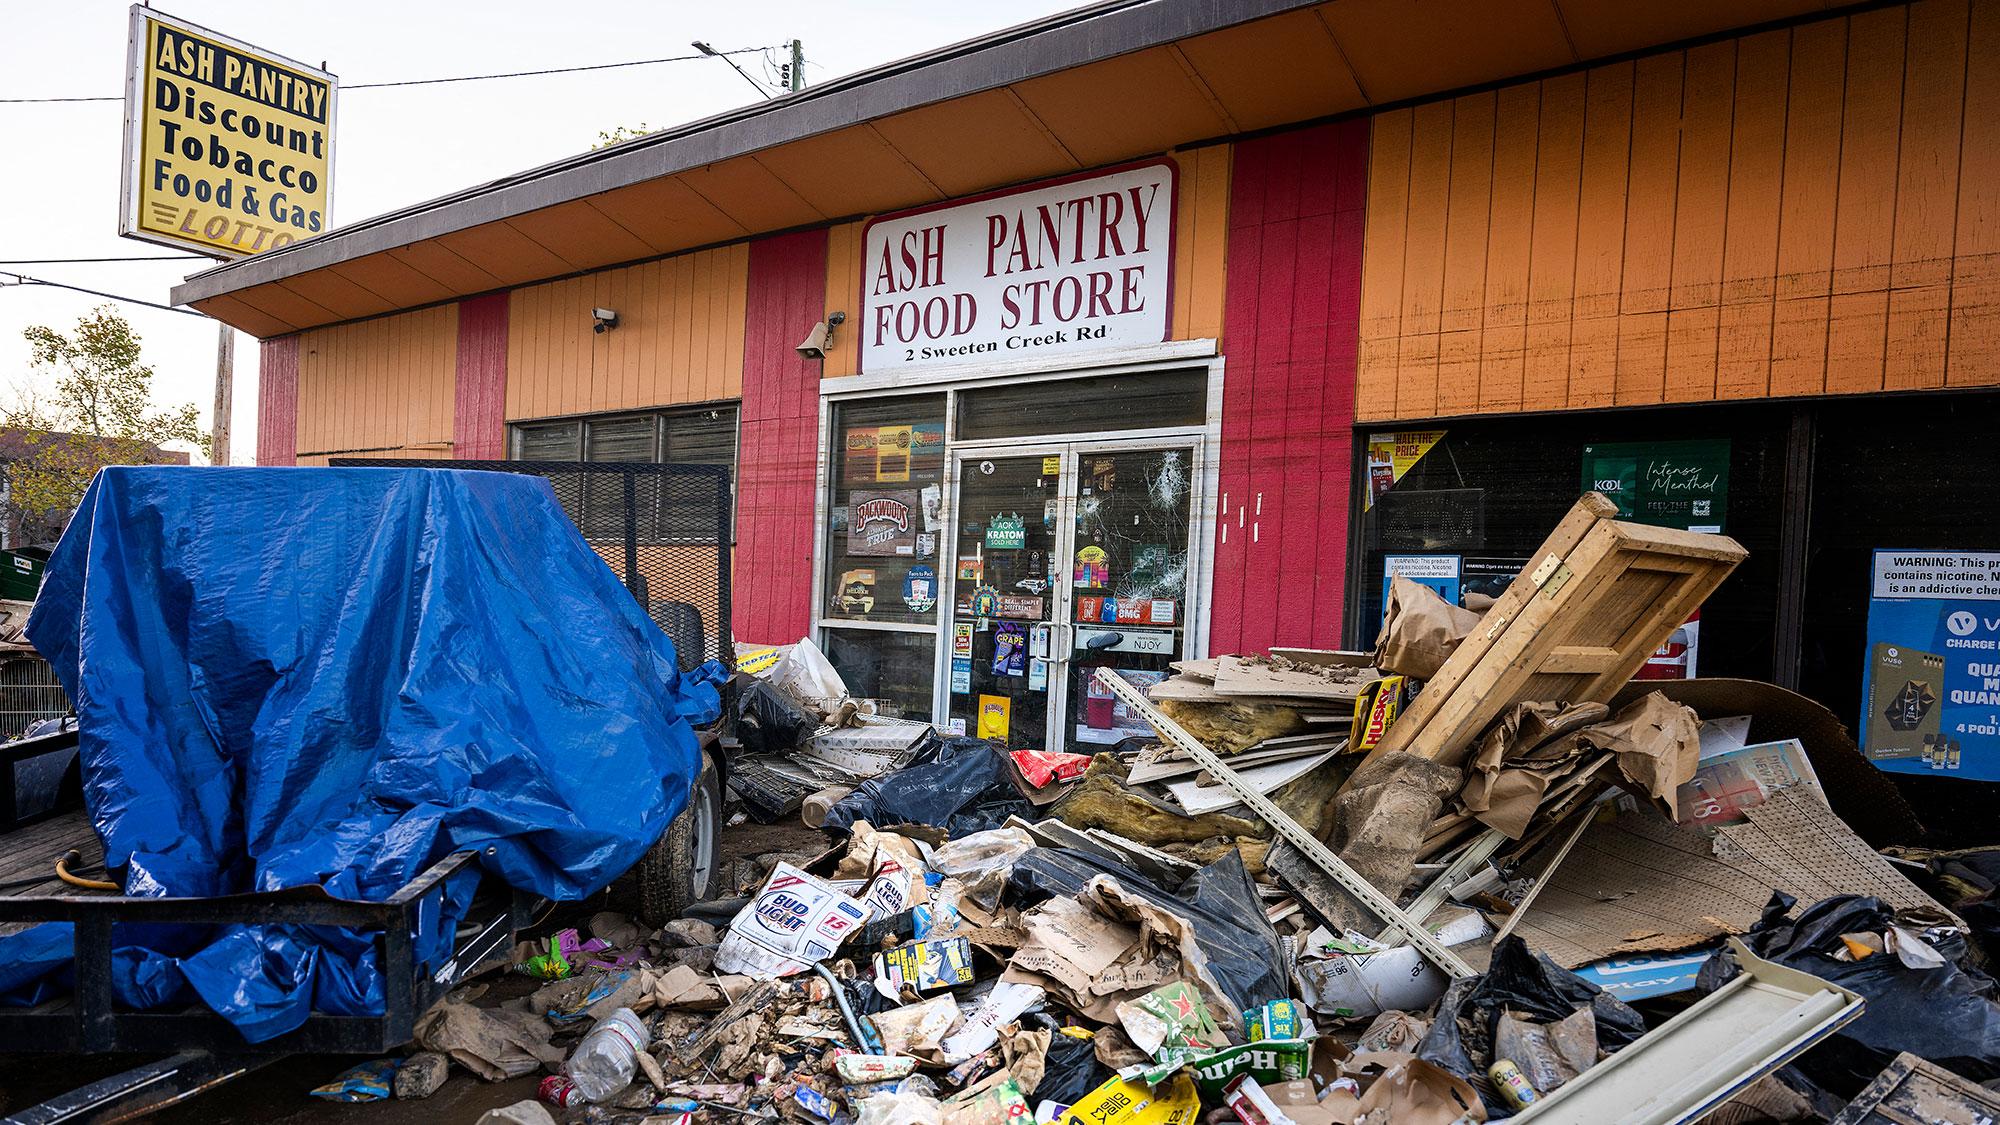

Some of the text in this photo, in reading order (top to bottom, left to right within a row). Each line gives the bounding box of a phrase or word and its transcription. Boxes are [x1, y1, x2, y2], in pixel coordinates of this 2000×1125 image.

[158, 33, 326, 118] ASH PANTRY
[155, 79, 323, 160] Discount
[159, 119, 318, 194] Tobacco
[154, 159, 321, 232] Food & Gas
[873, 183, 1160, 296] ASH PANTRY
[873, 265, 1146, 347] FOOD STORE
[904, 324, 1107, 362] 2 Sweeten Creek Rd
[1396, 433, 1416, 445] HALF
[1417, 432, 1433, 444] THE
[1395, 445, 1420, 457] PRICE
[1646, 460, 1702, 480] Intense
[1594, 479, 1624, 491] KOOL
[1651, 473, 1719, 496] Menthol
[857, 499, 909, 533] BACKWOODS
[866, 528, 895, 547] TRUE
[987, 531, 1024, 539] KRATOM
[1893, 557, 1957, 567] WARNING:
[1959, 558, 1985, 567] This
[1884, 571, 1933, 580] contains
[1936, 571, 1987, 581] nicotine.
[1889, 583, 1899, 592] is
[1902, 584, 1916, 592] an
[1919, 584, 1973, 595] addictive
[997, 634, 1024, 646] GRAPE
[1134, 641, 1162, 650] NJOY
[1946, 639, 1995, 650] CHARGE
[1365, 688, 1391, 745] HUSKY
[1956, 724, 1996, 735] 4 POD
[884, 882, 903, 902] BUD
[773, 894, 809, 915] BUD
[758, 904, 806, 932] LIGHT
[824, 916, 848, 929] 15
[1335, 965, 1348, 975] 96
[981, 1013, 999, 1028] IPA
